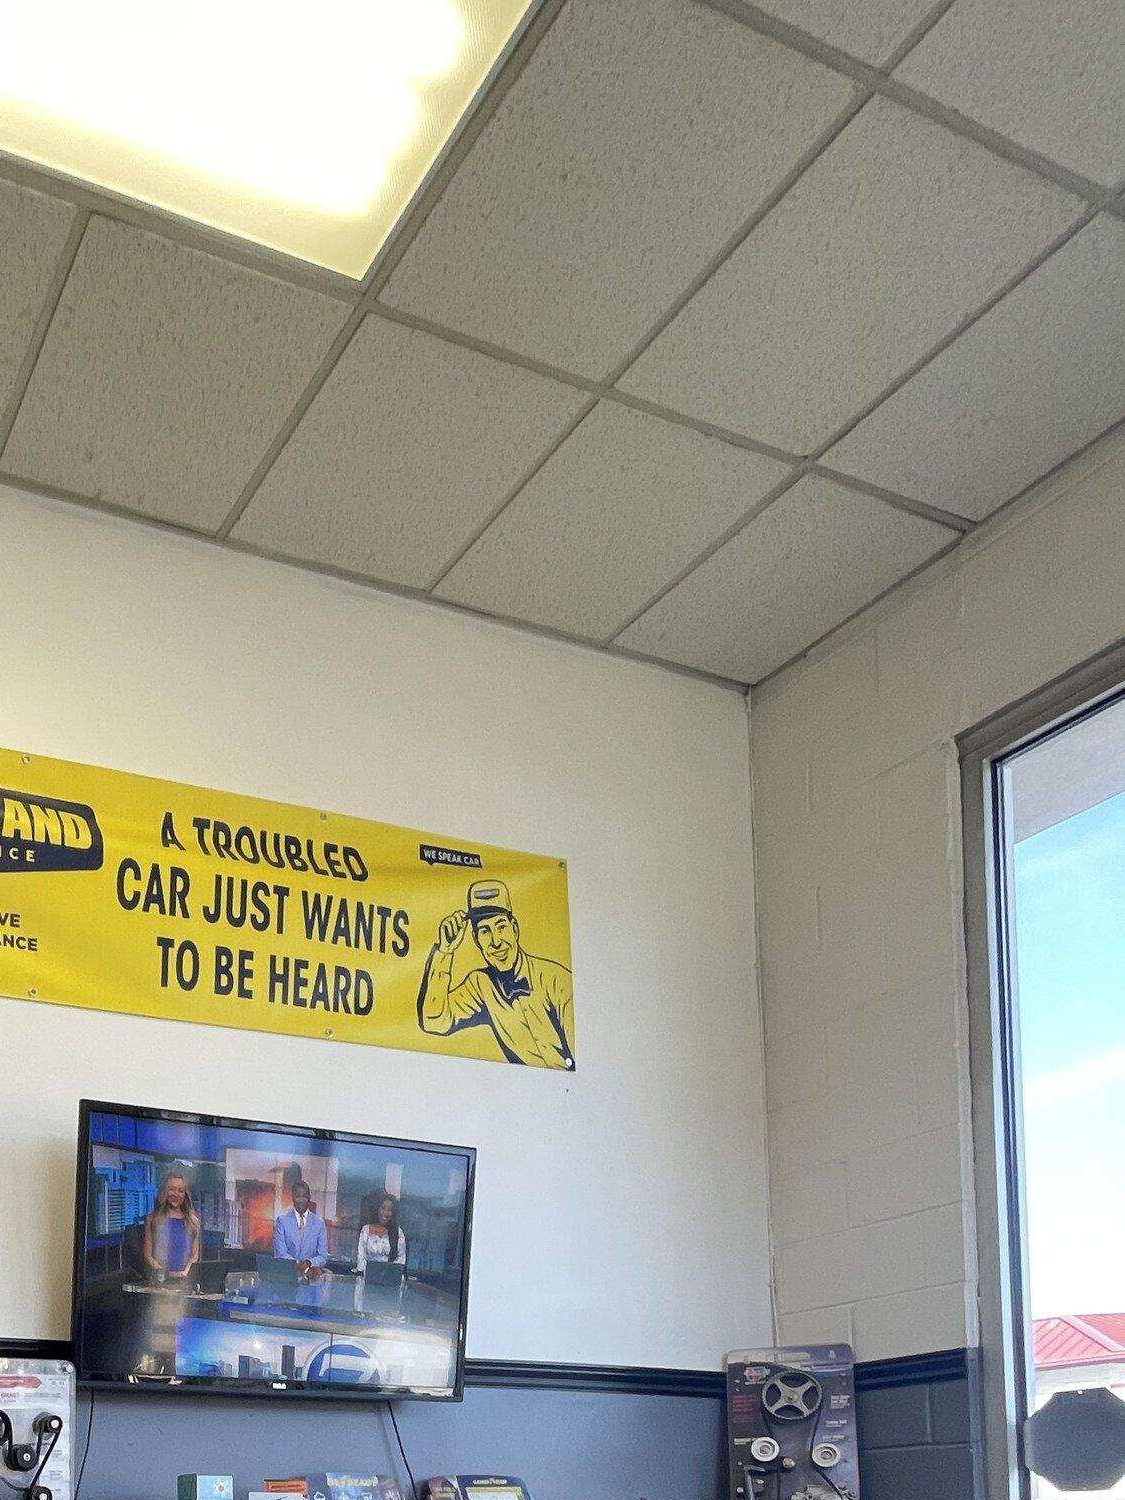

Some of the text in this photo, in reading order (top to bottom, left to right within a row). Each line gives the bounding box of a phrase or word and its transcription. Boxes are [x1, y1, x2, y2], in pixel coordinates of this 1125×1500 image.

[160, 812, 369, 882] A TROUBLED
[423, 848, 480, 866] WE SPEAK CAR
[116, 857, 410, 957] CAR JUST WANTS
[156, 937, 374, 1017] TO BE HEARD
